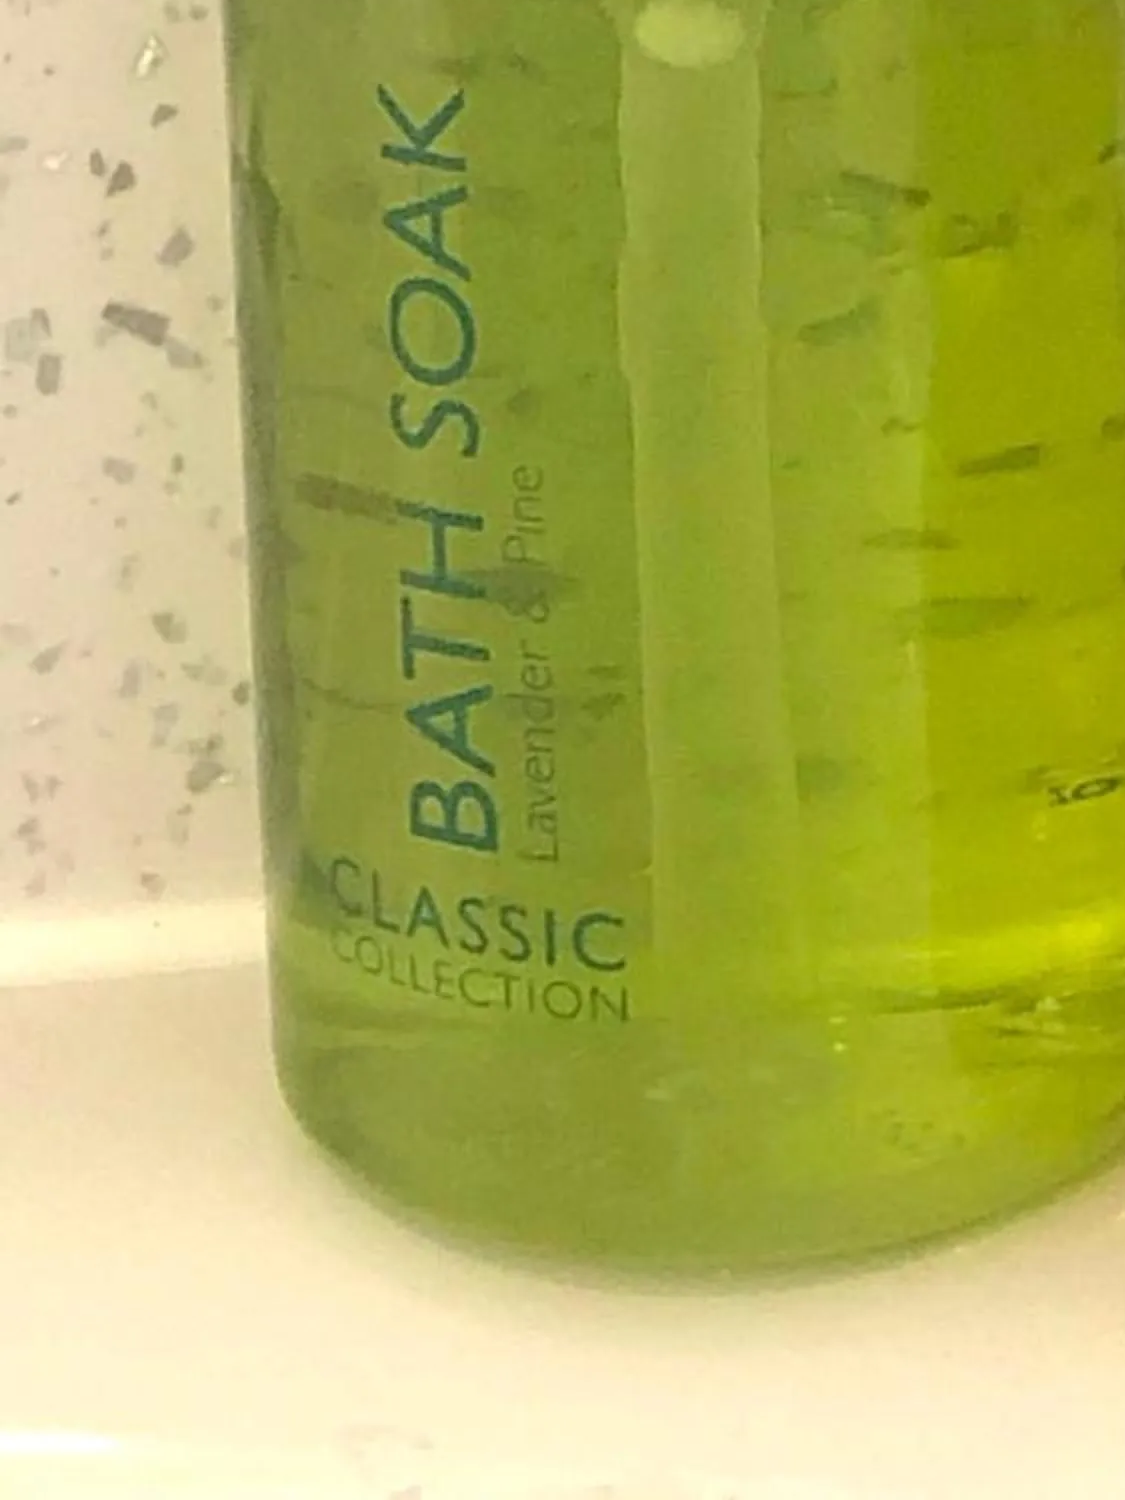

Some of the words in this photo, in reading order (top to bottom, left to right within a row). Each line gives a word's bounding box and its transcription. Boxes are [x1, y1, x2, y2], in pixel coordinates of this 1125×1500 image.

[377, 83, 481, 458] SOAK
[502, 462, 545, 567] Pine
[503, 589, 552, 625] &
[396, 497, 498, 853] BATH
[506, 646, 559, 864] Lavender
[328, 855, 627, 973] CLASSIC
[329, 926, 630, 1024] COLLECTION
